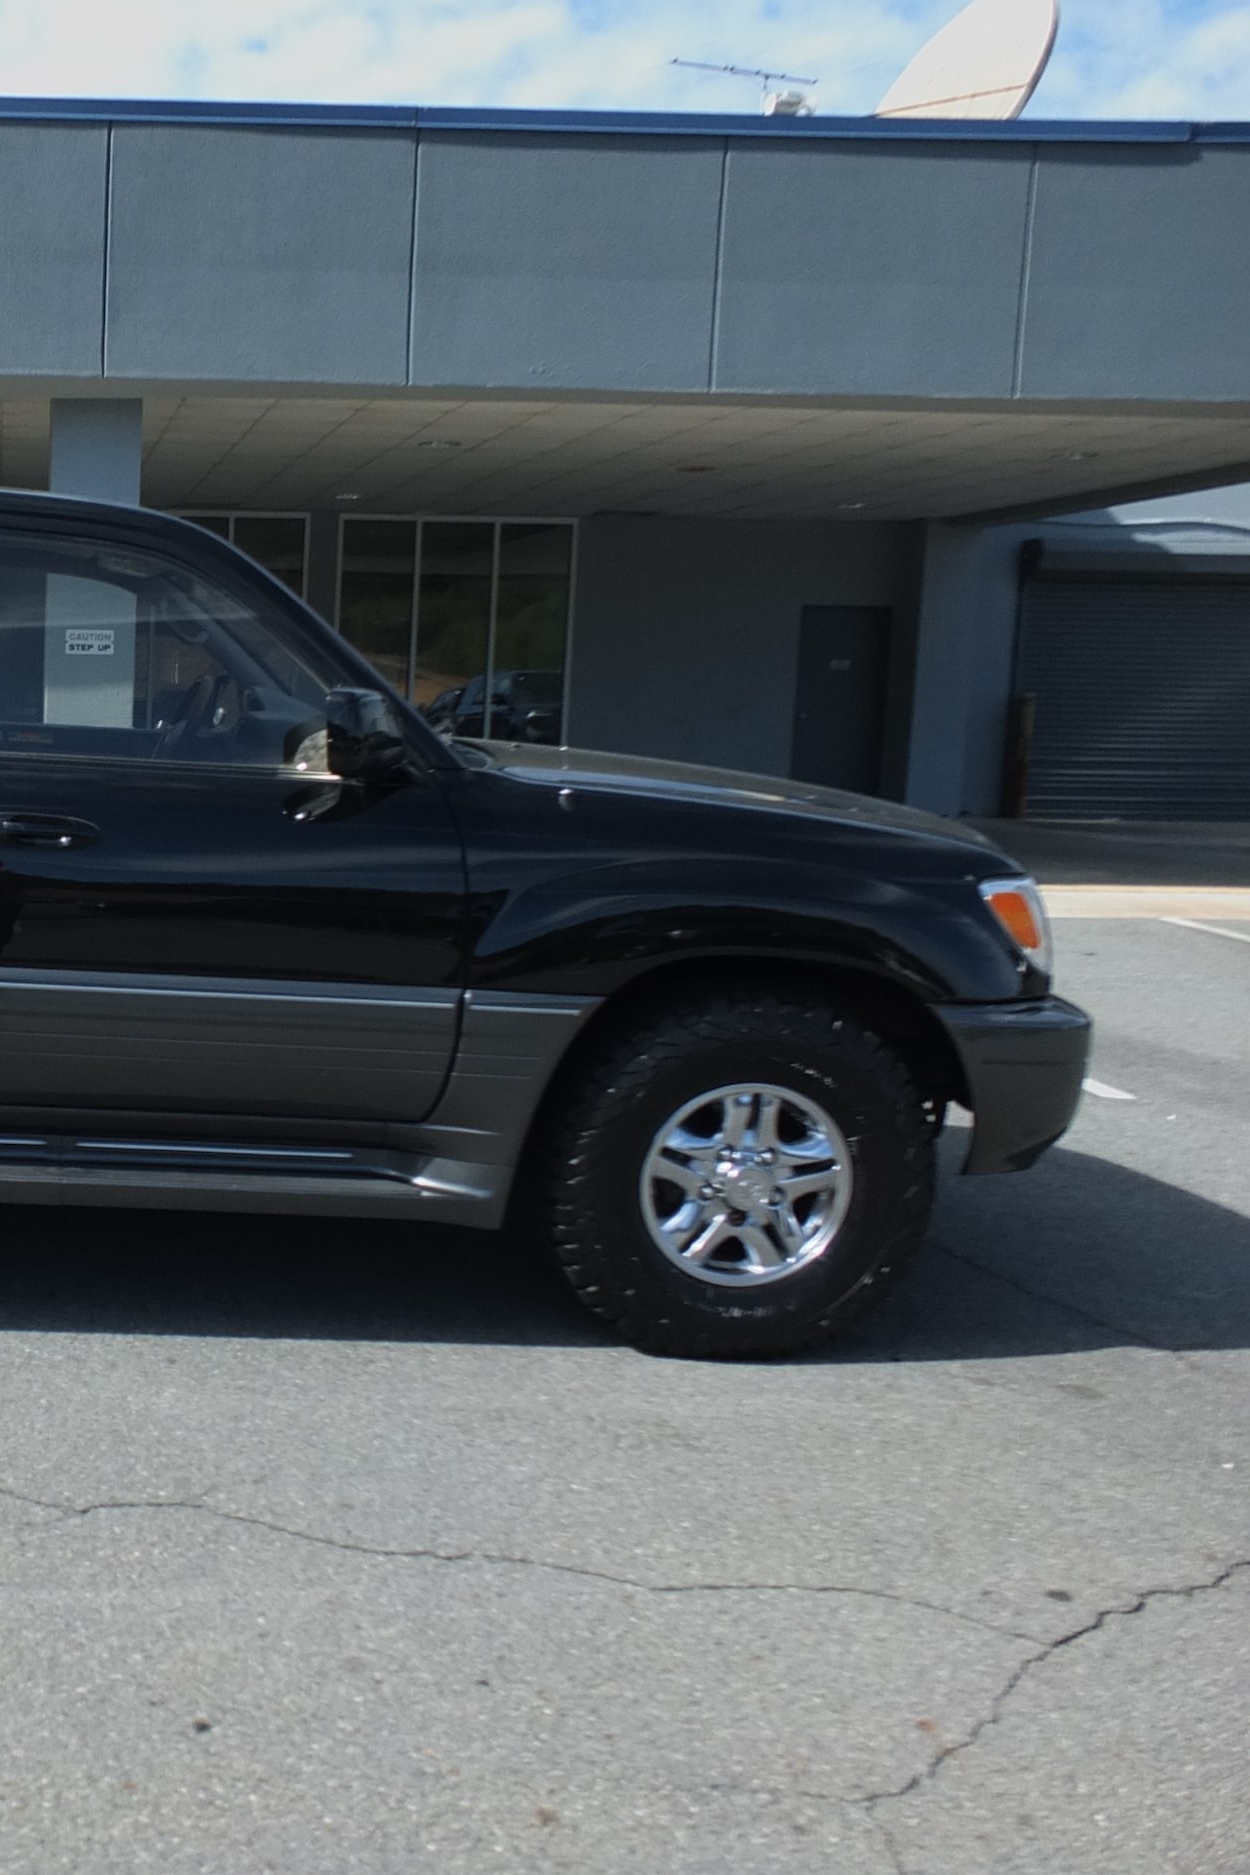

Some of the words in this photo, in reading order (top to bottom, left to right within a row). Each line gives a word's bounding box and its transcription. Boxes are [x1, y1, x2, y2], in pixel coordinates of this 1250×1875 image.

[69, 632, 112, 641] CAUTION
[68, 643, 94, 652] STEP
[97, 643, 112, 652] UP
